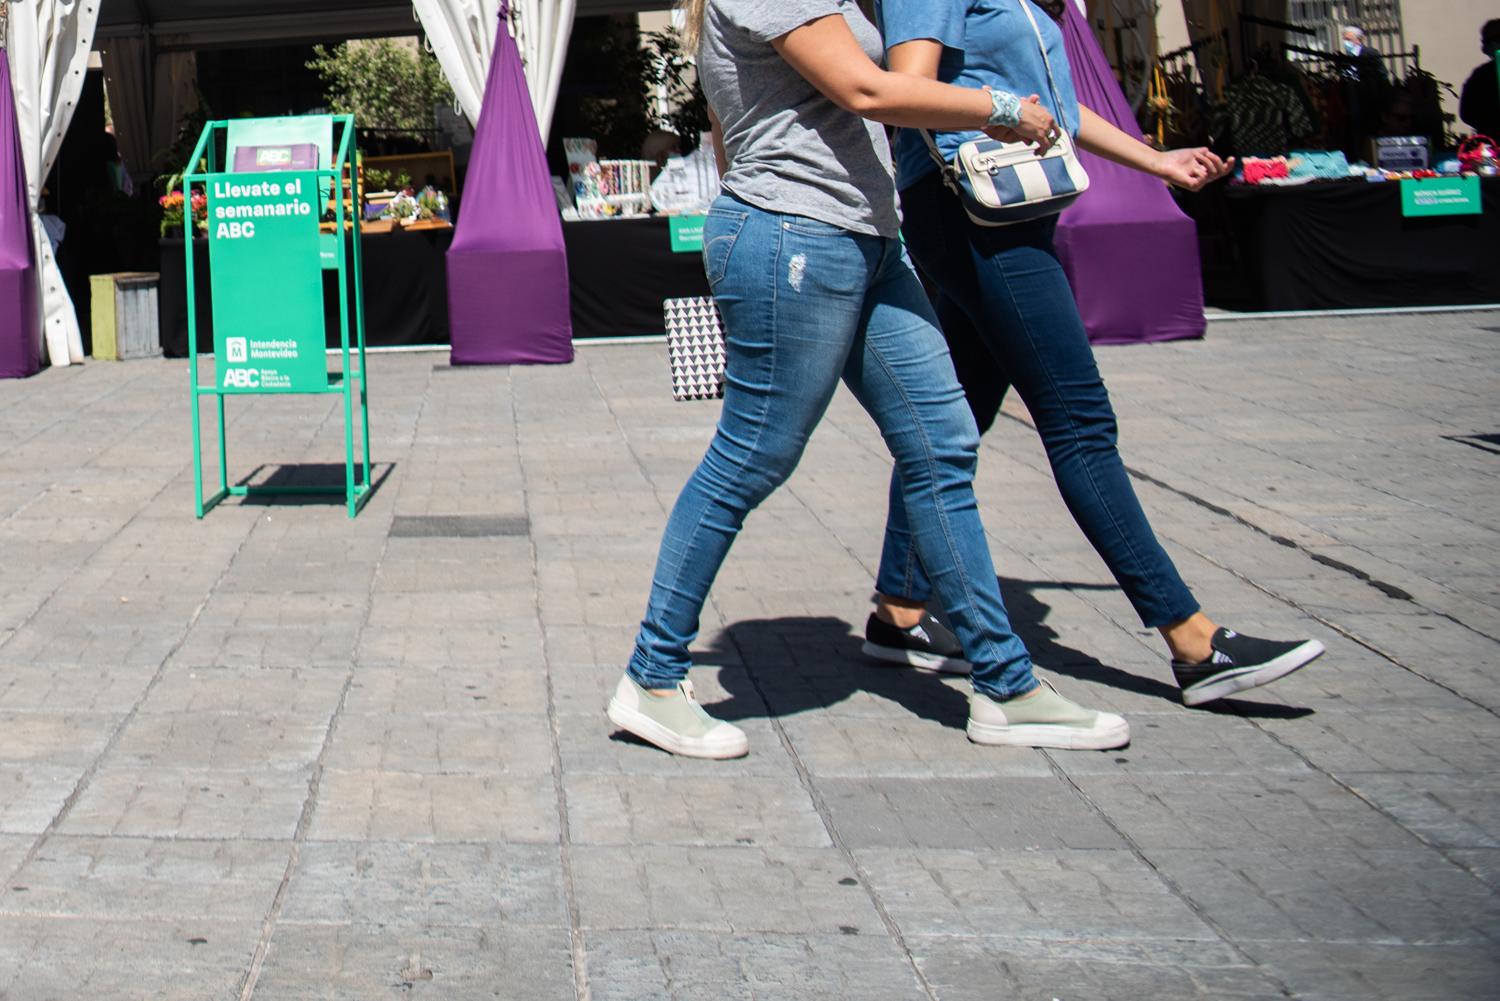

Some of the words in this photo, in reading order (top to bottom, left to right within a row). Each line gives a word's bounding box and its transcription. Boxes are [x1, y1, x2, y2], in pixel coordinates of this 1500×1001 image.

[259, 150, 289, 162] ABC
[214, 181, 281, 199] Llevate
[285, 178, 302, 195] el
[216, 199, 311, 219] semanario
[216, 221, 255, 240] ABC
[249, 338, 297, 349] Intendencia
[250, 348, 299, 358] Montevideo
[223, 367, 260, 388] ABC
